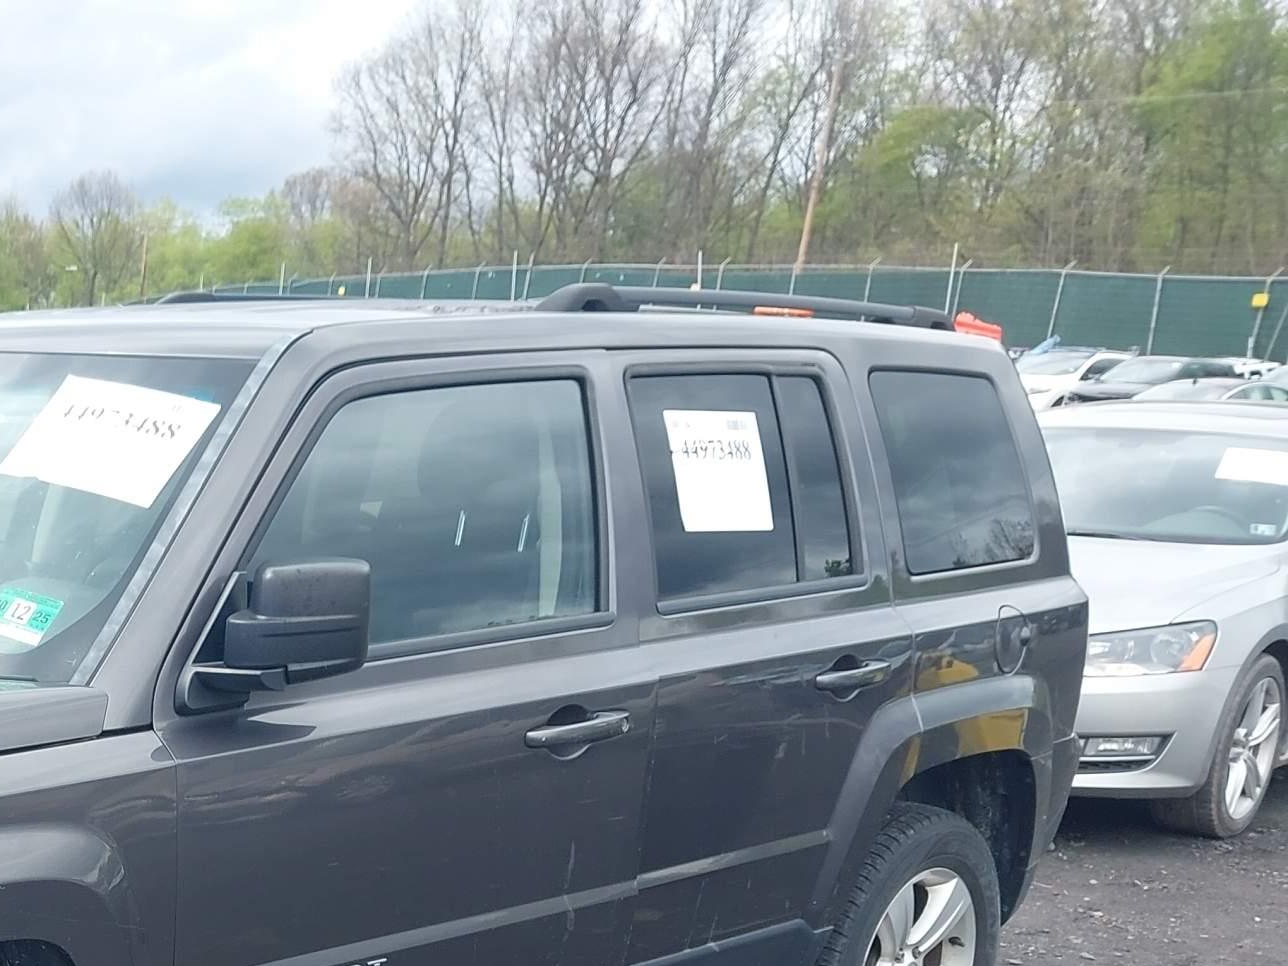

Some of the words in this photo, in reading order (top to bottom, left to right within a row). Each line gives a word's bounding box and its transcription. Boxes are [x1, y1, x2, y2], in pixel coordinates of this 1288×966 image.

[681, 439, 752, 460] 44973488
[10, 602, 33, 621] 12
[32, 611, 52, 624] 25
